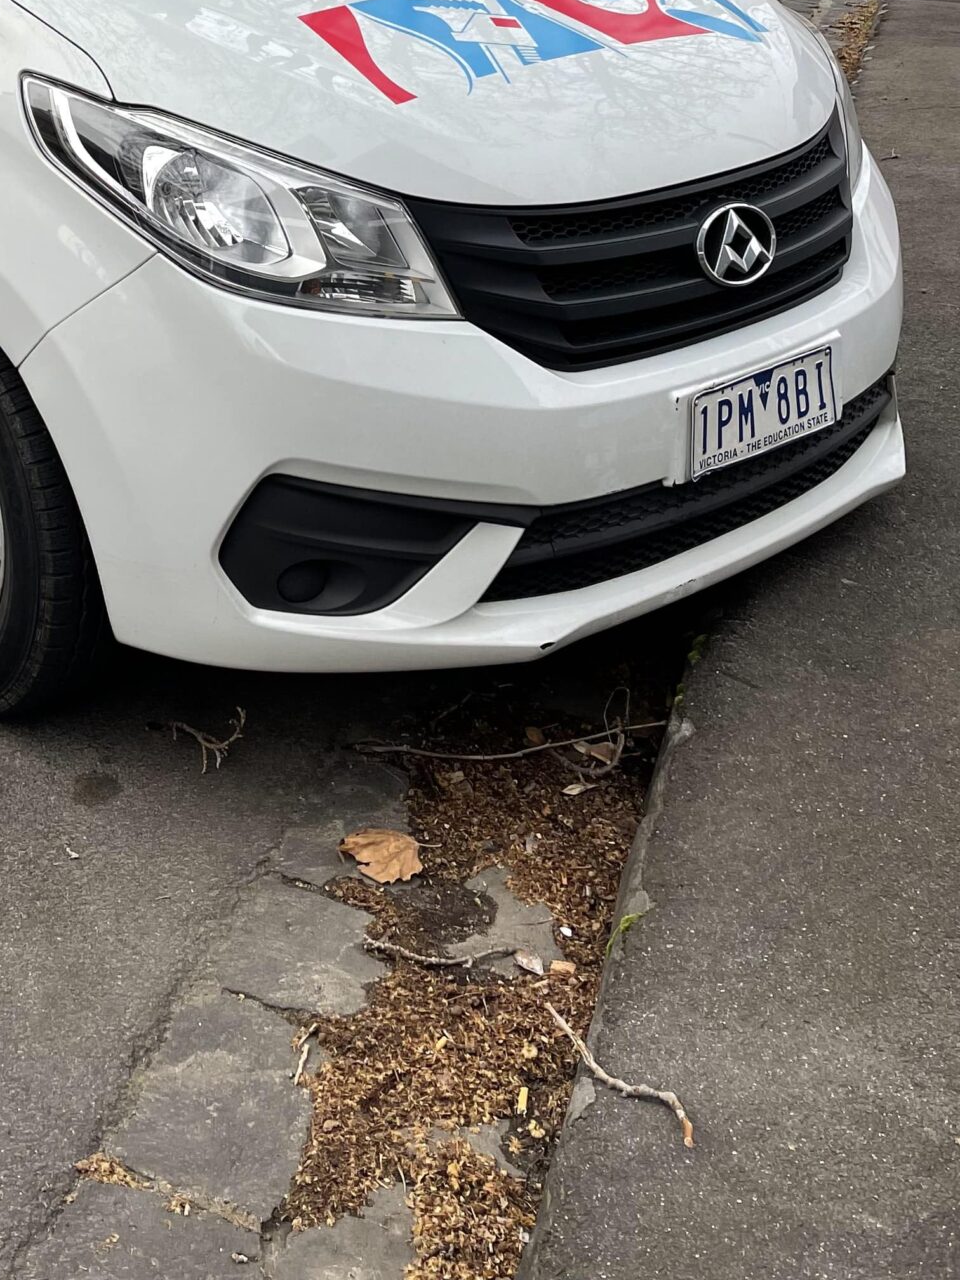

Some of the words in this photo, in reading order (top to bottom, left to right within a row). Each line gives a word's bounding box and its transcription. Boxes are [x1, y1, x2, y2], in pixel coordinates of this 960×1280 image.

[699, 448, 738, 469] VICTORIA
[746, 437, 762, 453] THE
[763, 420, 805, 447] EDUCATION
[807, 412, 828, 429] STATE
